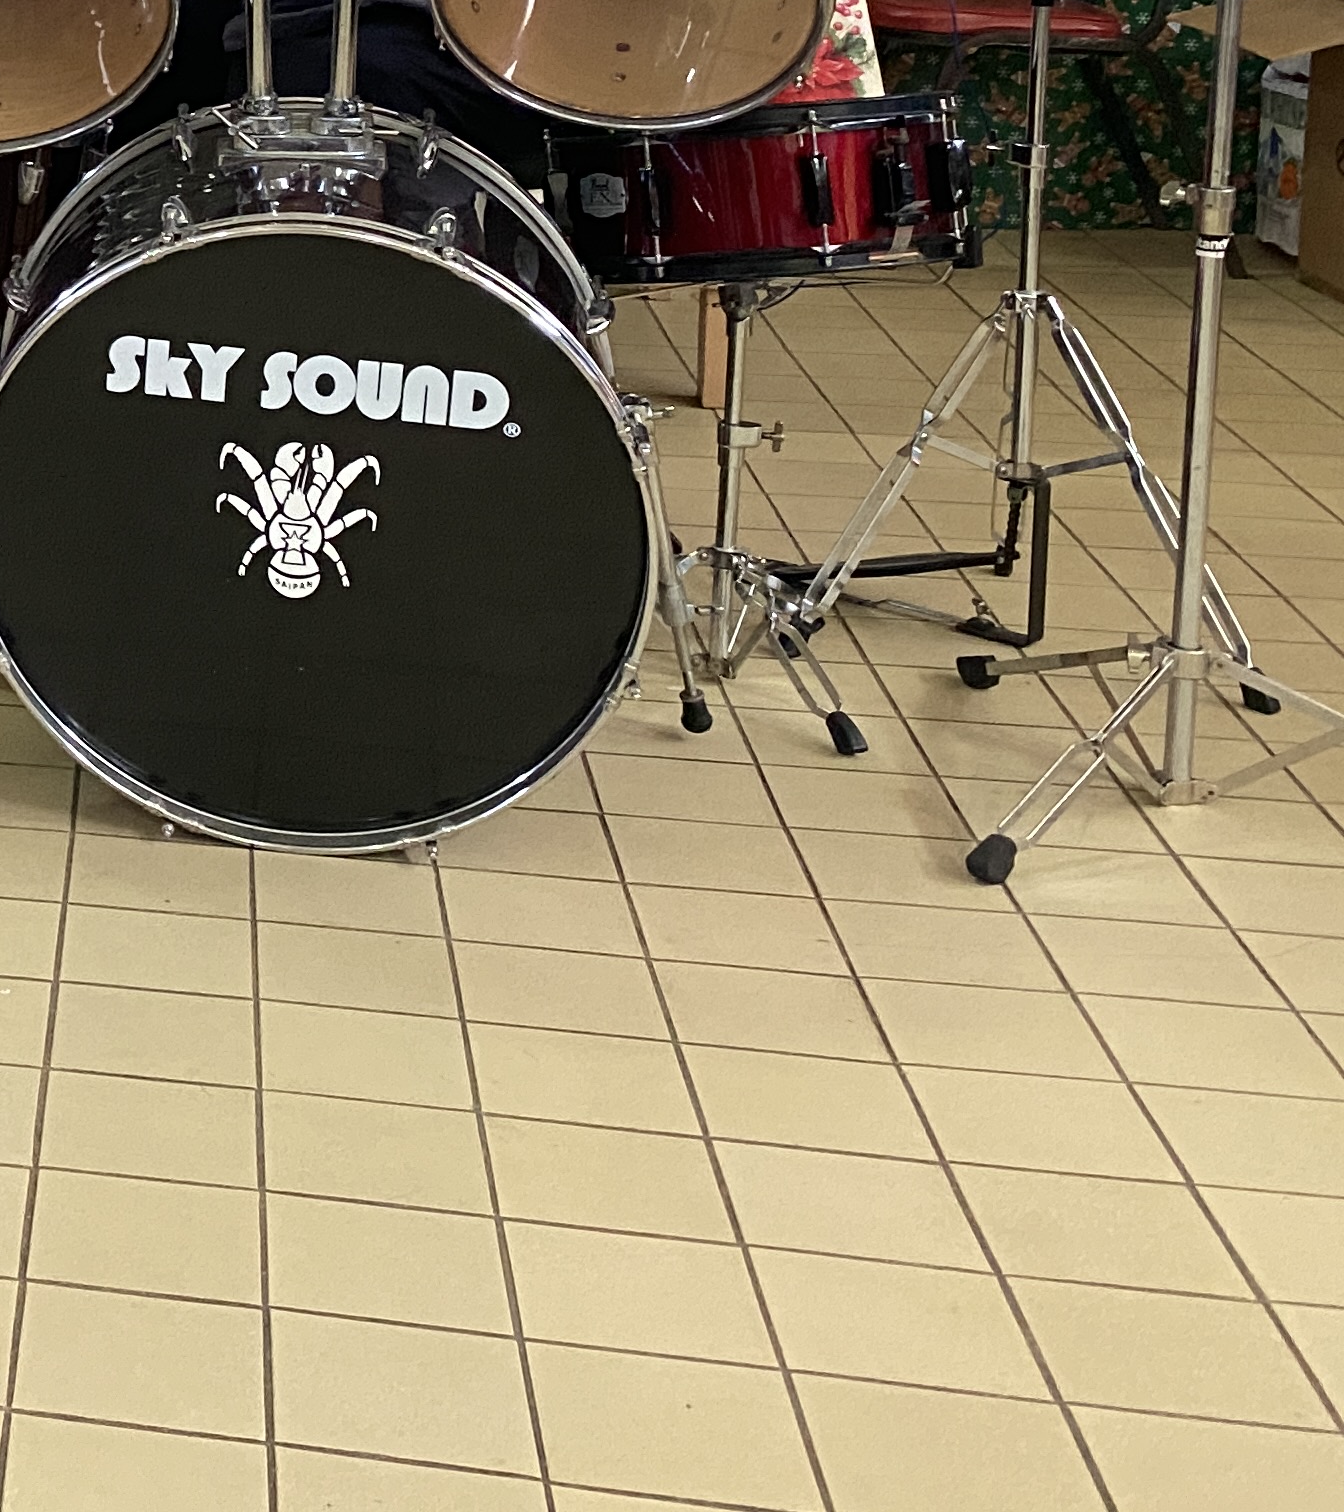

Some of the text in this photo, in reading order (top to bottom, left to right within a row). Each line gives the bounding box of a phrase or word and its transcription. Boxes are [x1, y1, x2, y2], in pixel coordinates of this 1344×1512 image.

[106, 335, 511, 431] SKY SOUND
[274, 577, 314, 591] SAIPAN
